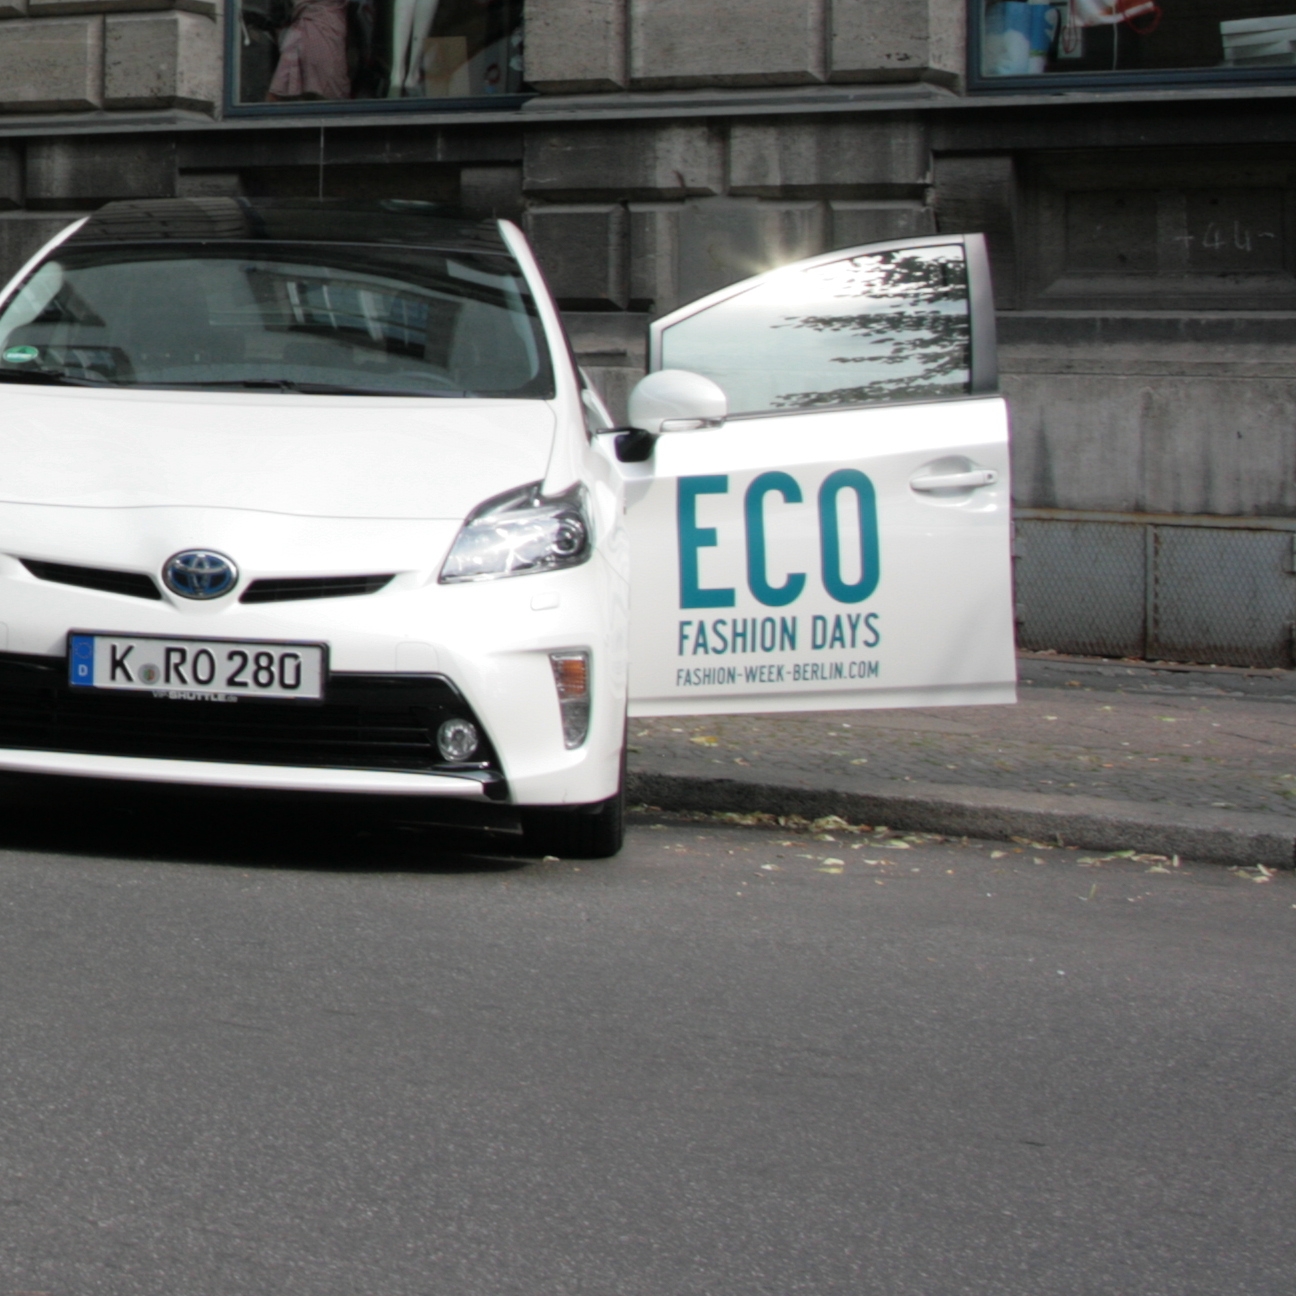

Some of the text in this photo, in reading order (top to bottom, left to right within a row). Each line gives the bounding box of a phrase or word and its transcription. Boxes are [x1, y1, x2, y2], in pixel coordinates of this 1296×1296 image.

[677, 468, 881, 610] ECO
[678, 611, 881, 656] FASHION DAYS
[110, 643, 135, 682] K
[226, 649, 303, 690] 280
[676, 661, 880, 687] FASHION-WEEK-BERLIN.COM
